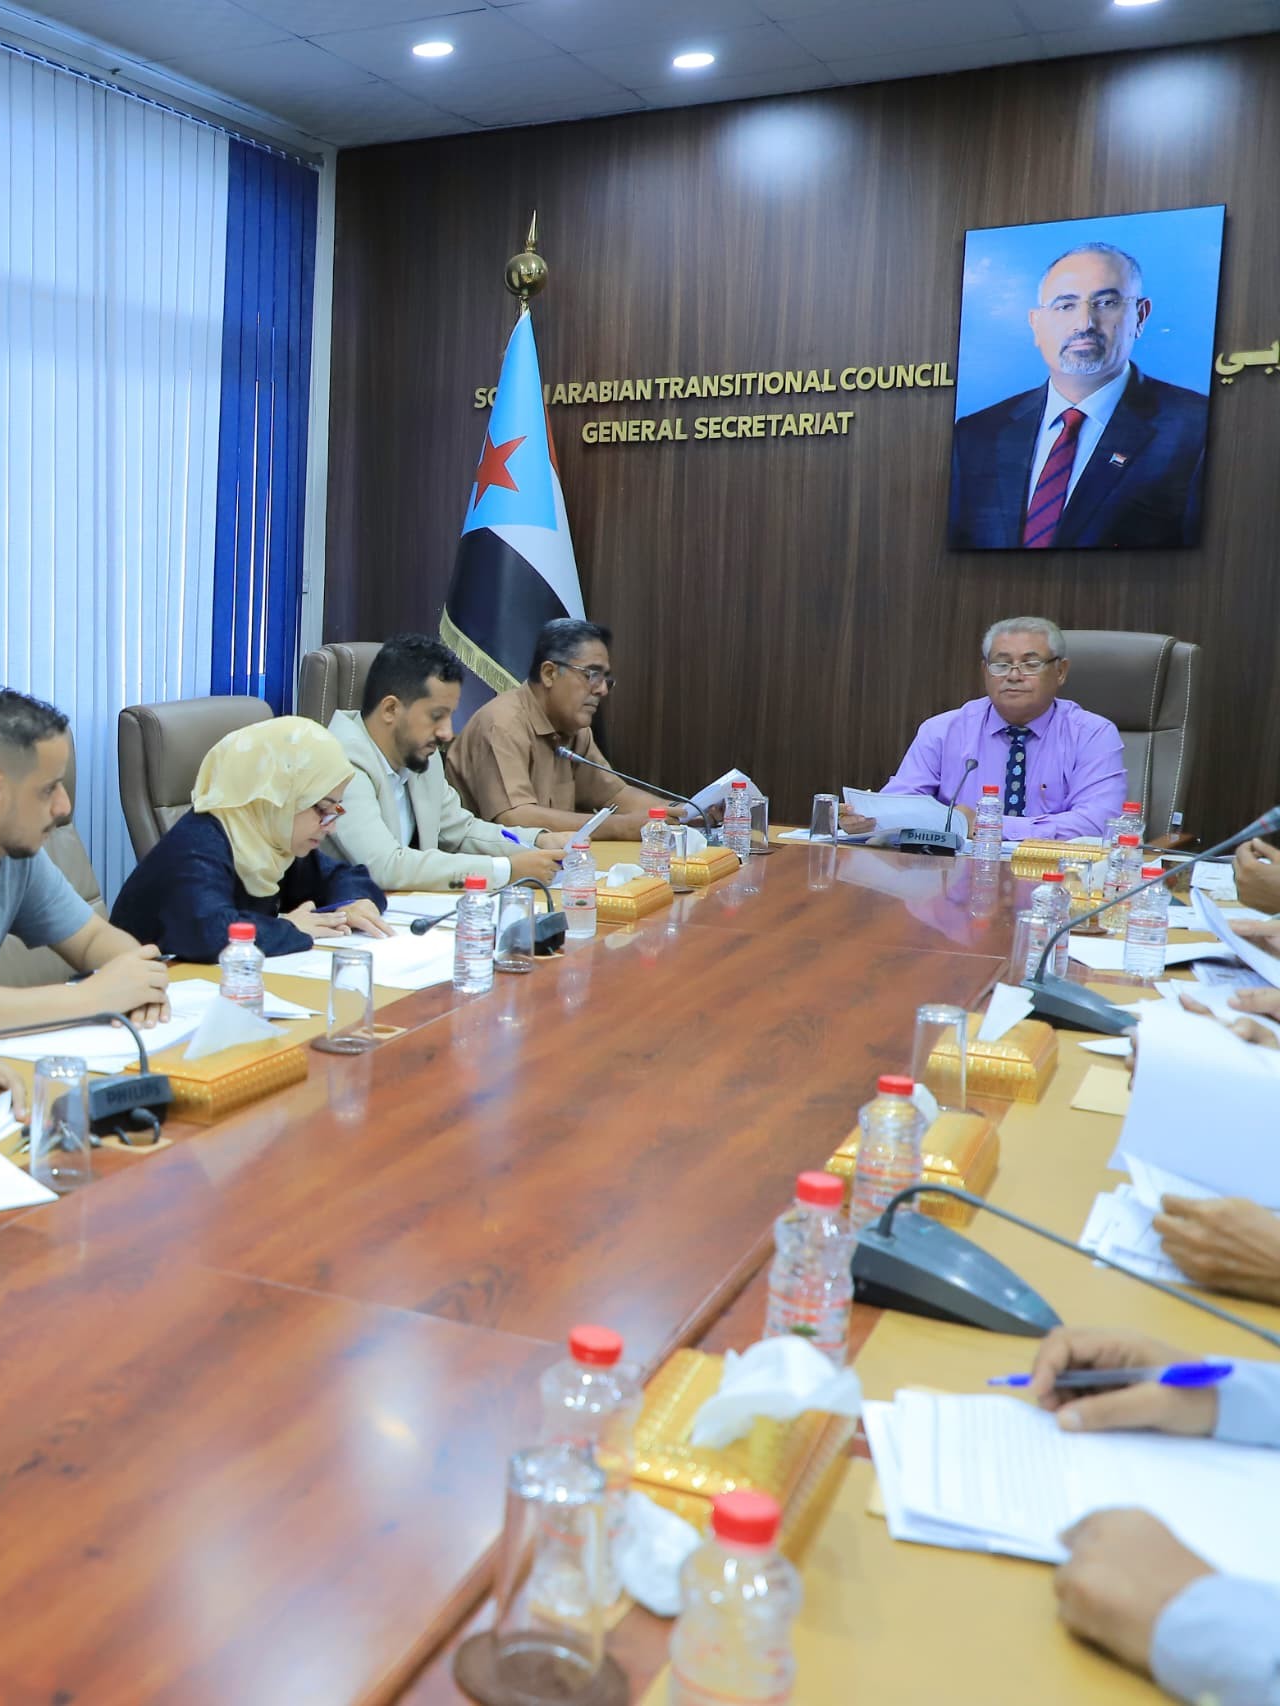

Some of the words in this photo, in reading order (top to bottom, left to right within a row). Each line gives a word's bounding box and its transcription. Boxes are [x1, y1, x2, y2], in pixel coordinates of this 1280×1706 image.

[551, 379, 652, 405] ARABIAN
[655, 368, 837, 399] TRANSITIONAL
[840, 362, 955, 391] COUNCIL
[582, 418, 688, 443] GENERAL
[694, 411, 854, 439] SECRETARIAT
[907, 831, 947, 843] PHILIPS
